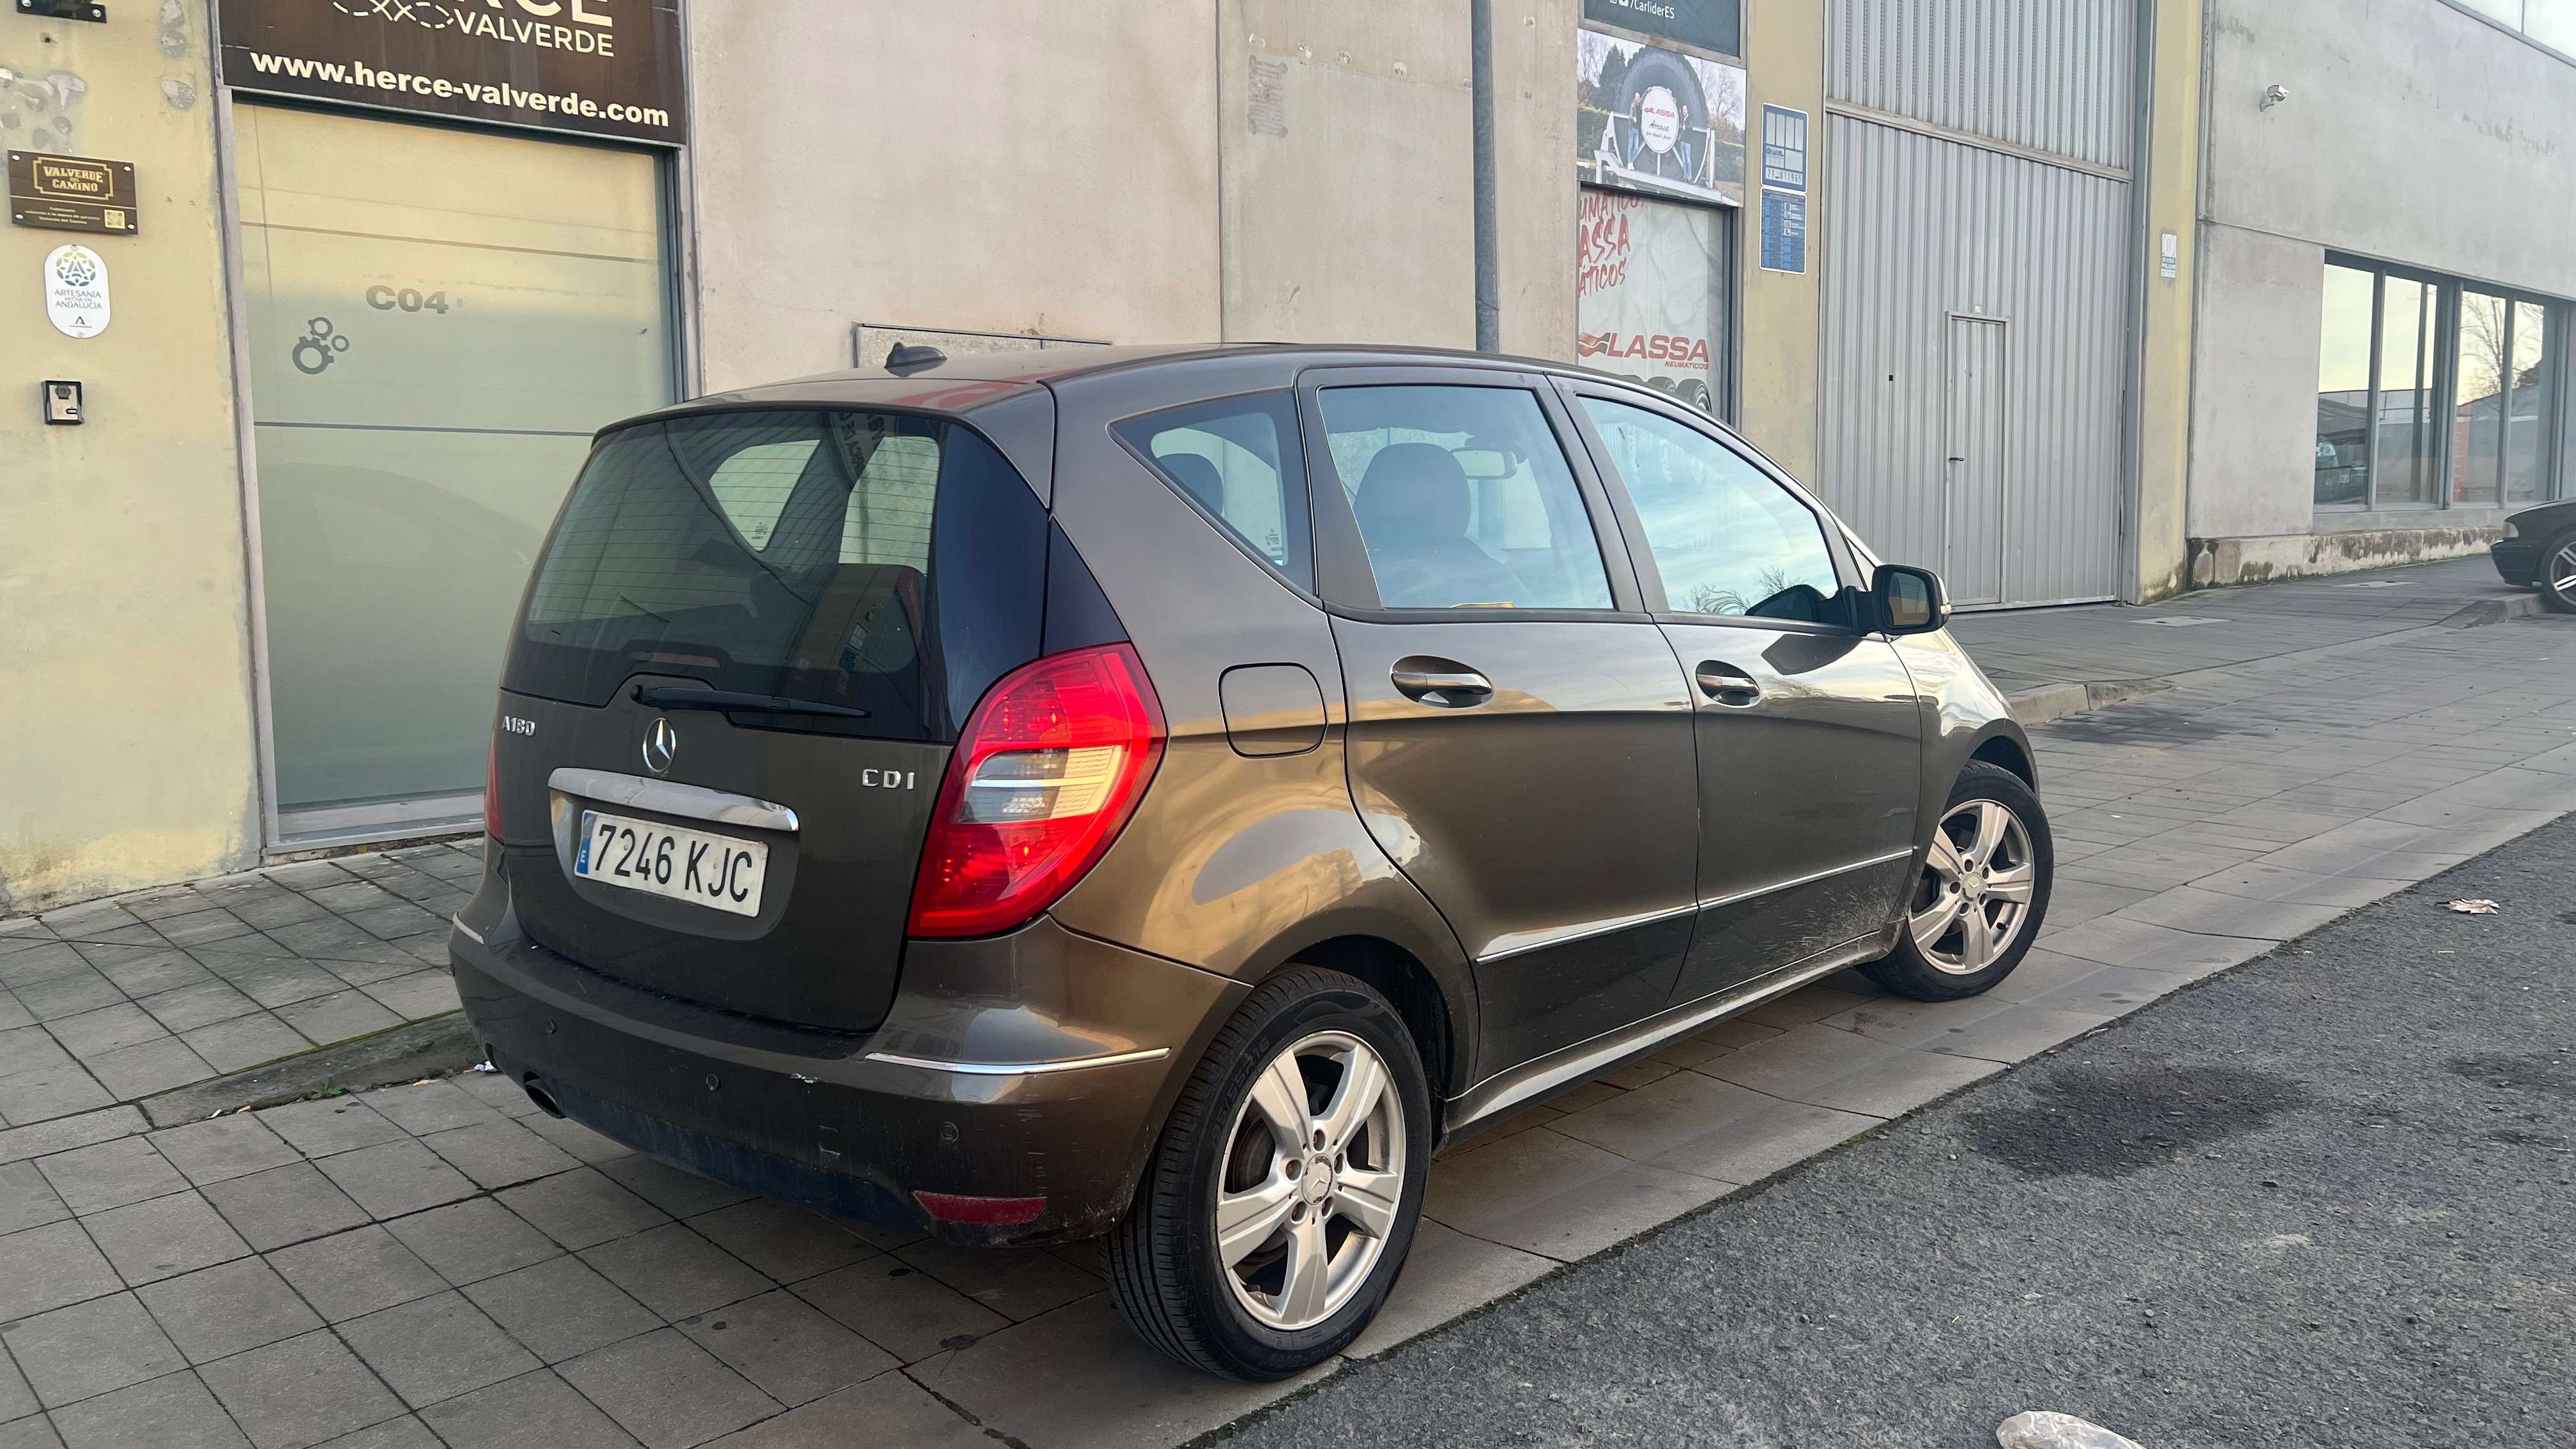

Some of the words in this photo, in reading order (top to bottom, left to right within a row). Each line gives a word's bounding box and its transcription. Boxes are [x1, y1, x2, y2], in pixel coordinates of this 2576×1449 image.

[454, 8, 615, 57] VALVERDE
[249, 51, 670, 127] www.herce-valverde.com
[1651, 107, 1675, 118] LASSA
[43, 165, 104, 183] VALVERDE
[52, 178, 98, 192] CAMINO
[54, 289, 102, 298] ARTESANÍA
[55, 300, 102, 310] ANDALUCÍA
[1607, 332, 1709, 363] LASSA
[501, 715, 535, 736] A180
[862, 769, 915, 790] CDI
[580, 849, 586, 863] E
[595, 824, 675, 885] 7246
[685, 840, 753, 902] KJC
